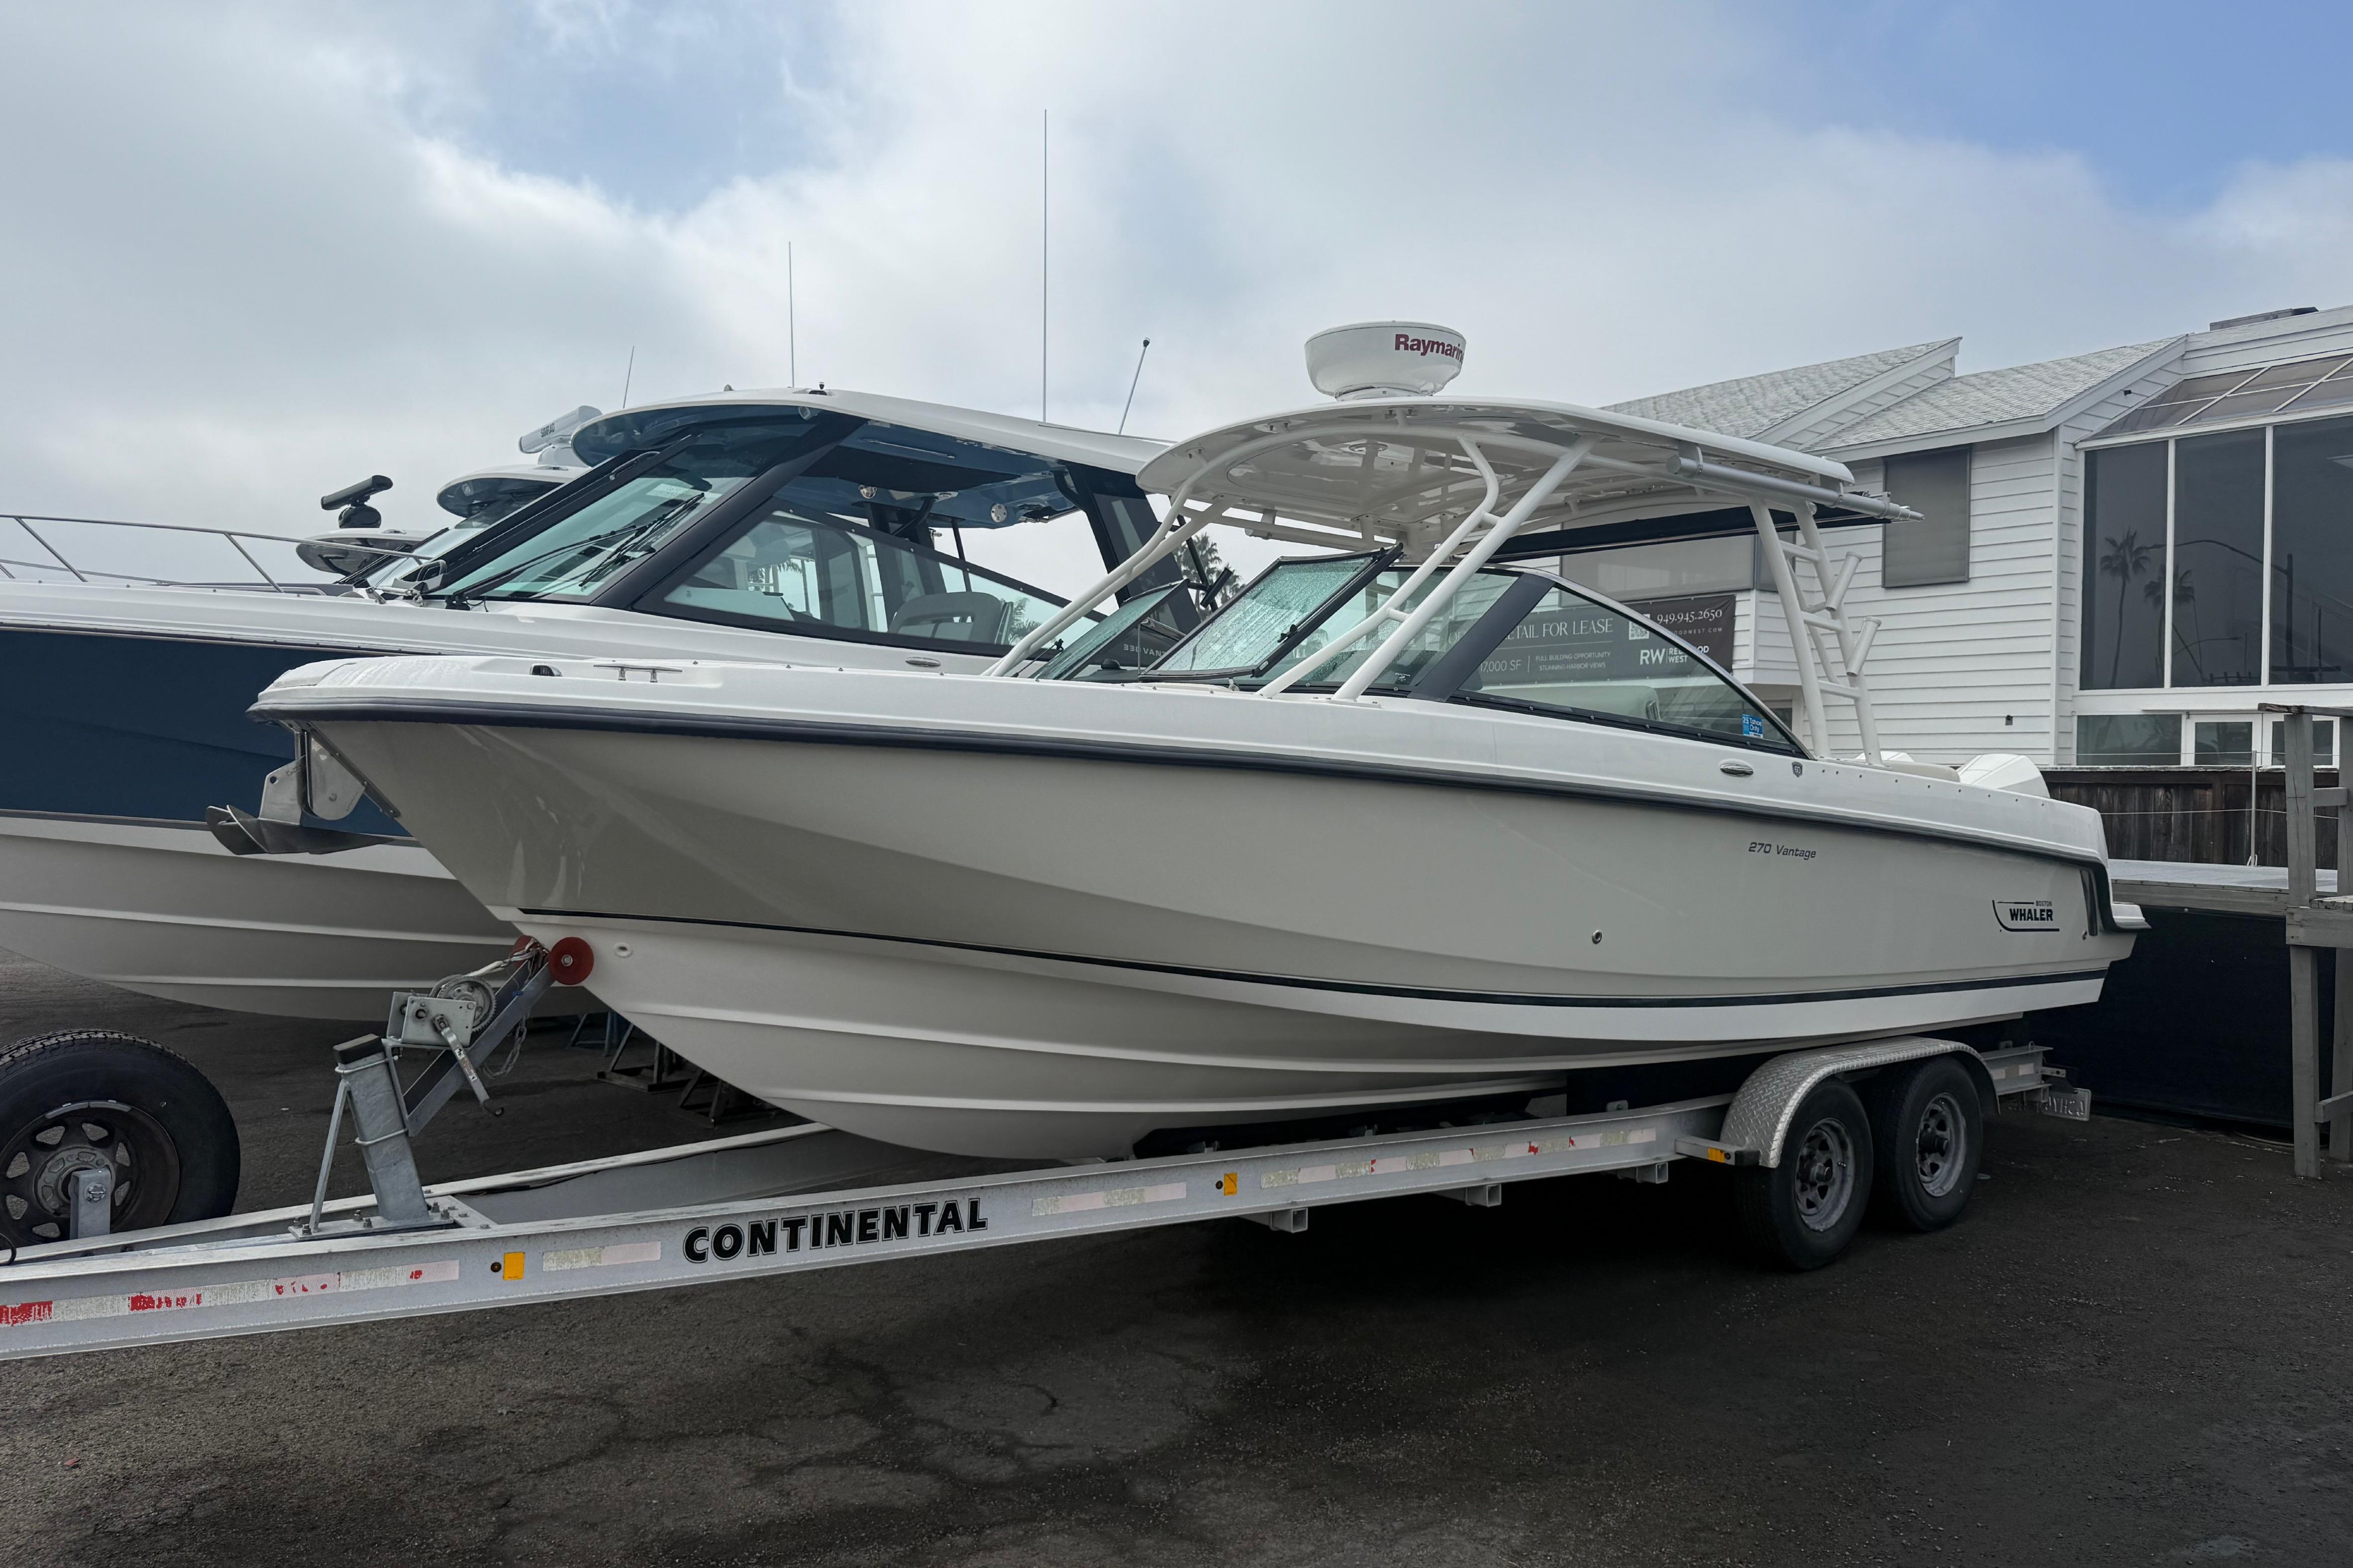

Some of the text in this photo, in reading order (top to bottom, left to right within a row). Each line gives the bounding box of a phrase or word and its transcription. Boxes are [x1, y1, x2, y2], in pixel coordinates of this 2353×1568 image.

[1657, 608, 1723, 624] 949.945.2650
[1505, 618, 1614, 640] ETAIL FOR LEASE
[1574, 651, 1612, 660] OPPORTUNITY
[1639, 648, 1666, 665] RW
[1668, 655, 1689, 663] WEST
[1510, 660, 1522, 671] SF
[1749, 718, 1762, 726] Tahoe
[1750, 724, 1759, 733] Only
[1748, 842, 1816, 860] 270 Vantage
[2009, 908, 2053, 921] WHALER
[683, 1198, 988, 1264] CONTINENTAL
